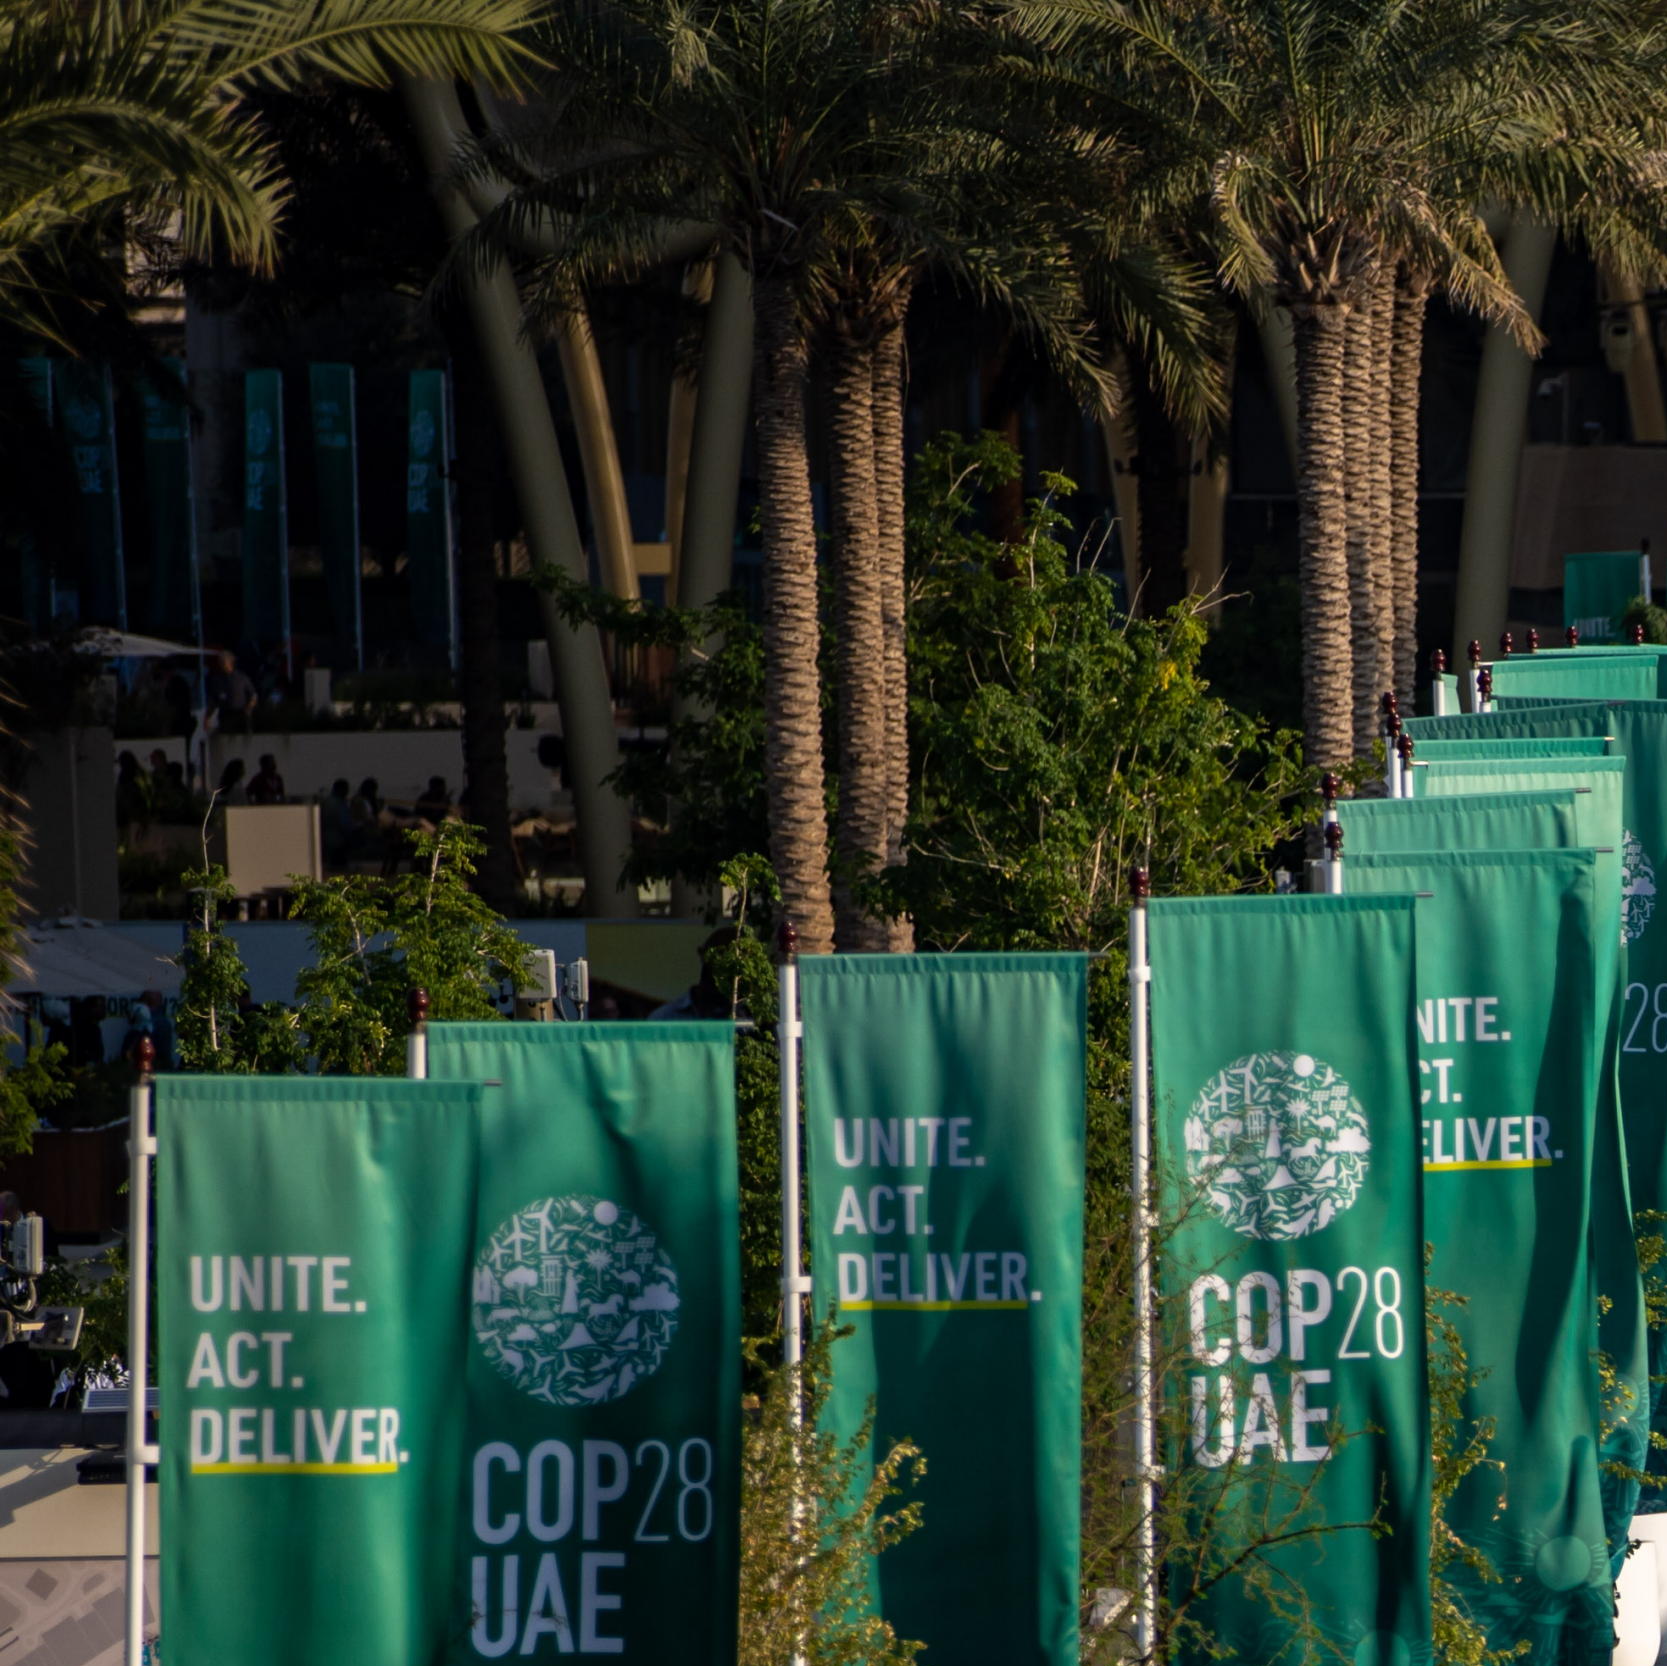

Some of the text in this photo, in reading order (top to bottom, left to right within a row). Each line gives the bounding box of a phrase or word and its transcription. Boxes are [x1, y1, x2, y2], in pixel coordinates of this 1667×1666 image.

[1416, 997, 1512, 1044] NITE.
[834, 1117, 986, 1169] UNITE.
[1421, 1115, 1563, 1164] ELIVER.
[833, 1184, 935, 1236] ACT.
[189, 1255, 367, 1313] UNITE.
[838, 1251, 1043, 1302] DELIVER.
[1188, 1266, 1404, 1368] COP28
[186, 1331, 304, 1389] ACT.
[190, 1407, 410, 1465] DELIVER.
[1190, 1368, 1333, 1469] UAE
[472, 1437, 713, 1545] COP28
[471, 1552, 627, 1659] UAE
